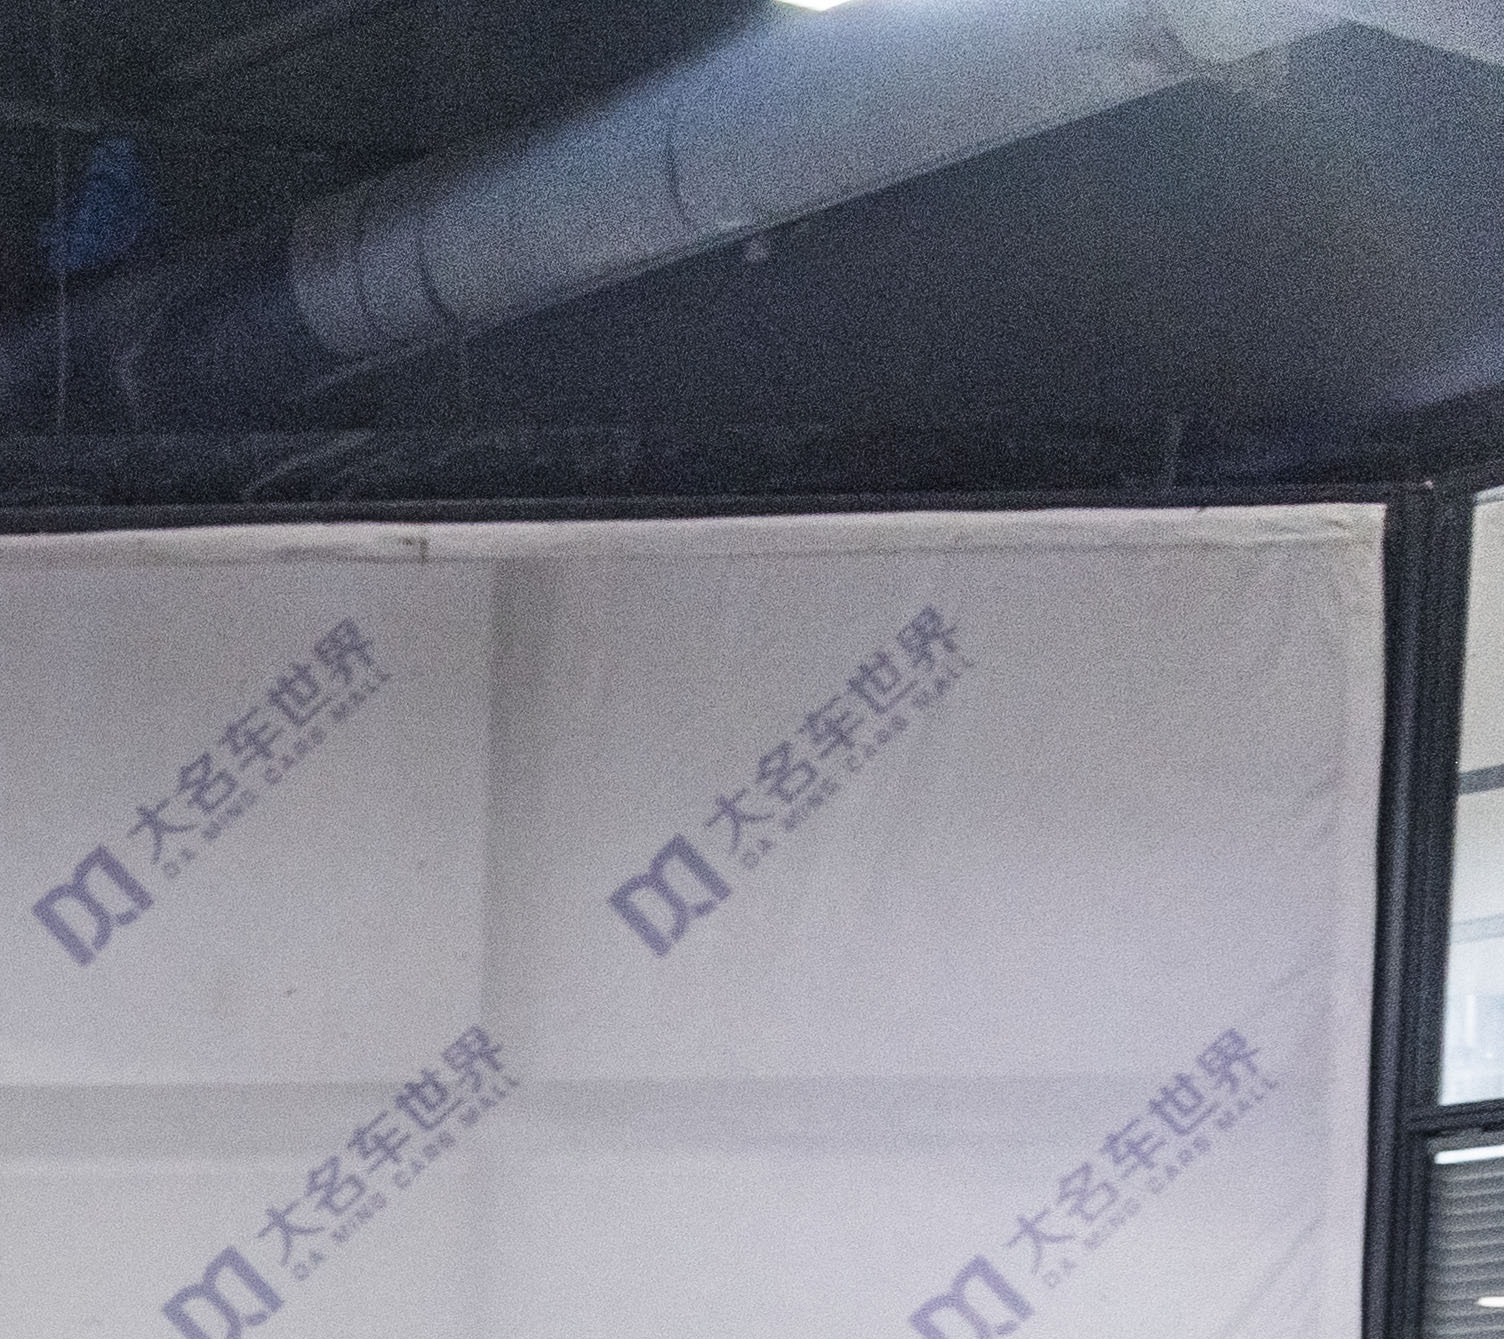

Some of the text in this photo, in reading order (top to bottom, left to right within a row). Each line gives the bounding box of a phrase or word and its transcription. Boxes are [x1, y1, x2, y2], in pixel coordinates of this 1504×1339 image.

[127, 618, 376, 866] 大名车世界
[705, 606, 959, 856] 大名车世界
[256, 1025, 505, 1267] 大名车世界
[1006, 1027, 1261, 1276] 大名车世界
